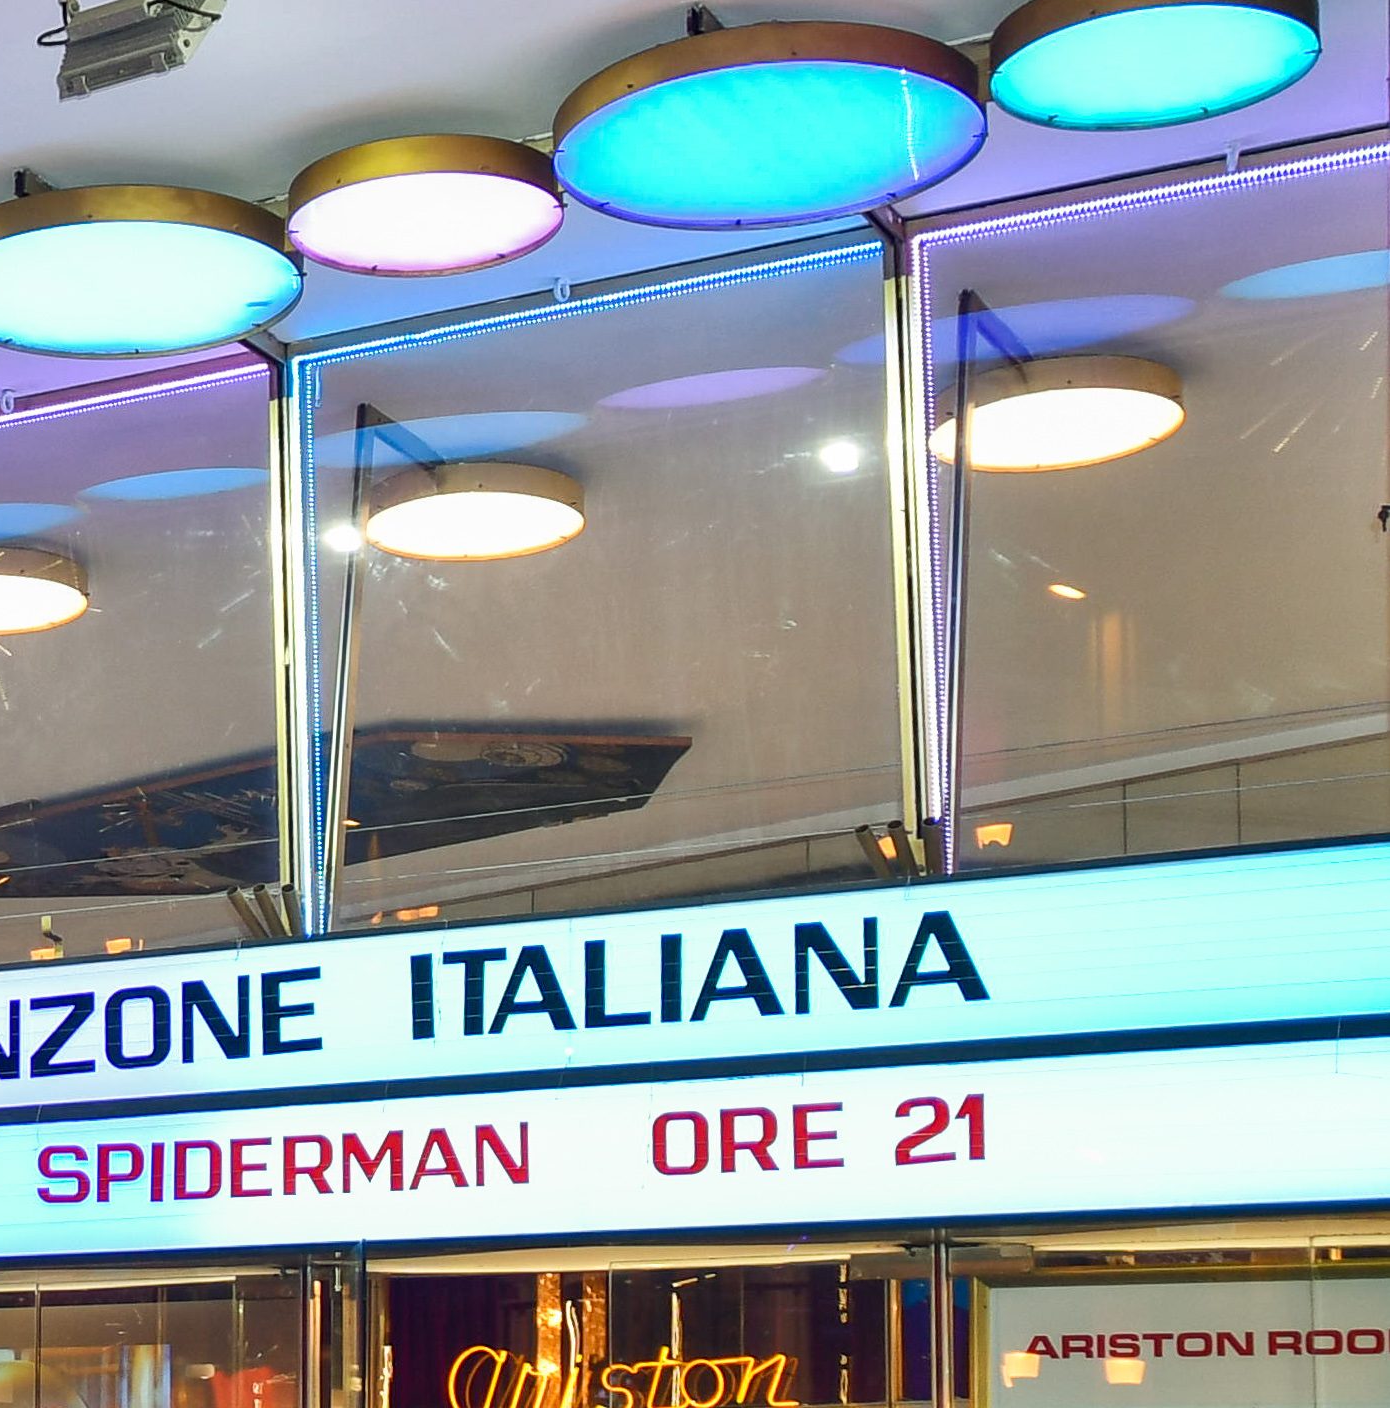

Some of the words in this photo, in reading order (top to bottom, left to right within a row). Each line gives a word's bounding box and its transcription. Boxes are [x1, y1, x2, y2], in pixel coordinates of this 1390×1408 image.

[410, 911, 990, 1042] ITALIANA
[37, 1121, 530, 1205] SPIDERMAN
[652, 1102, 845, 1176] ORE
[894, 1093, 986, 1167] 21
[1025, 1331, 1255, 1360] ARISTON
[1268, 1328, 1390, 1356] ROO
